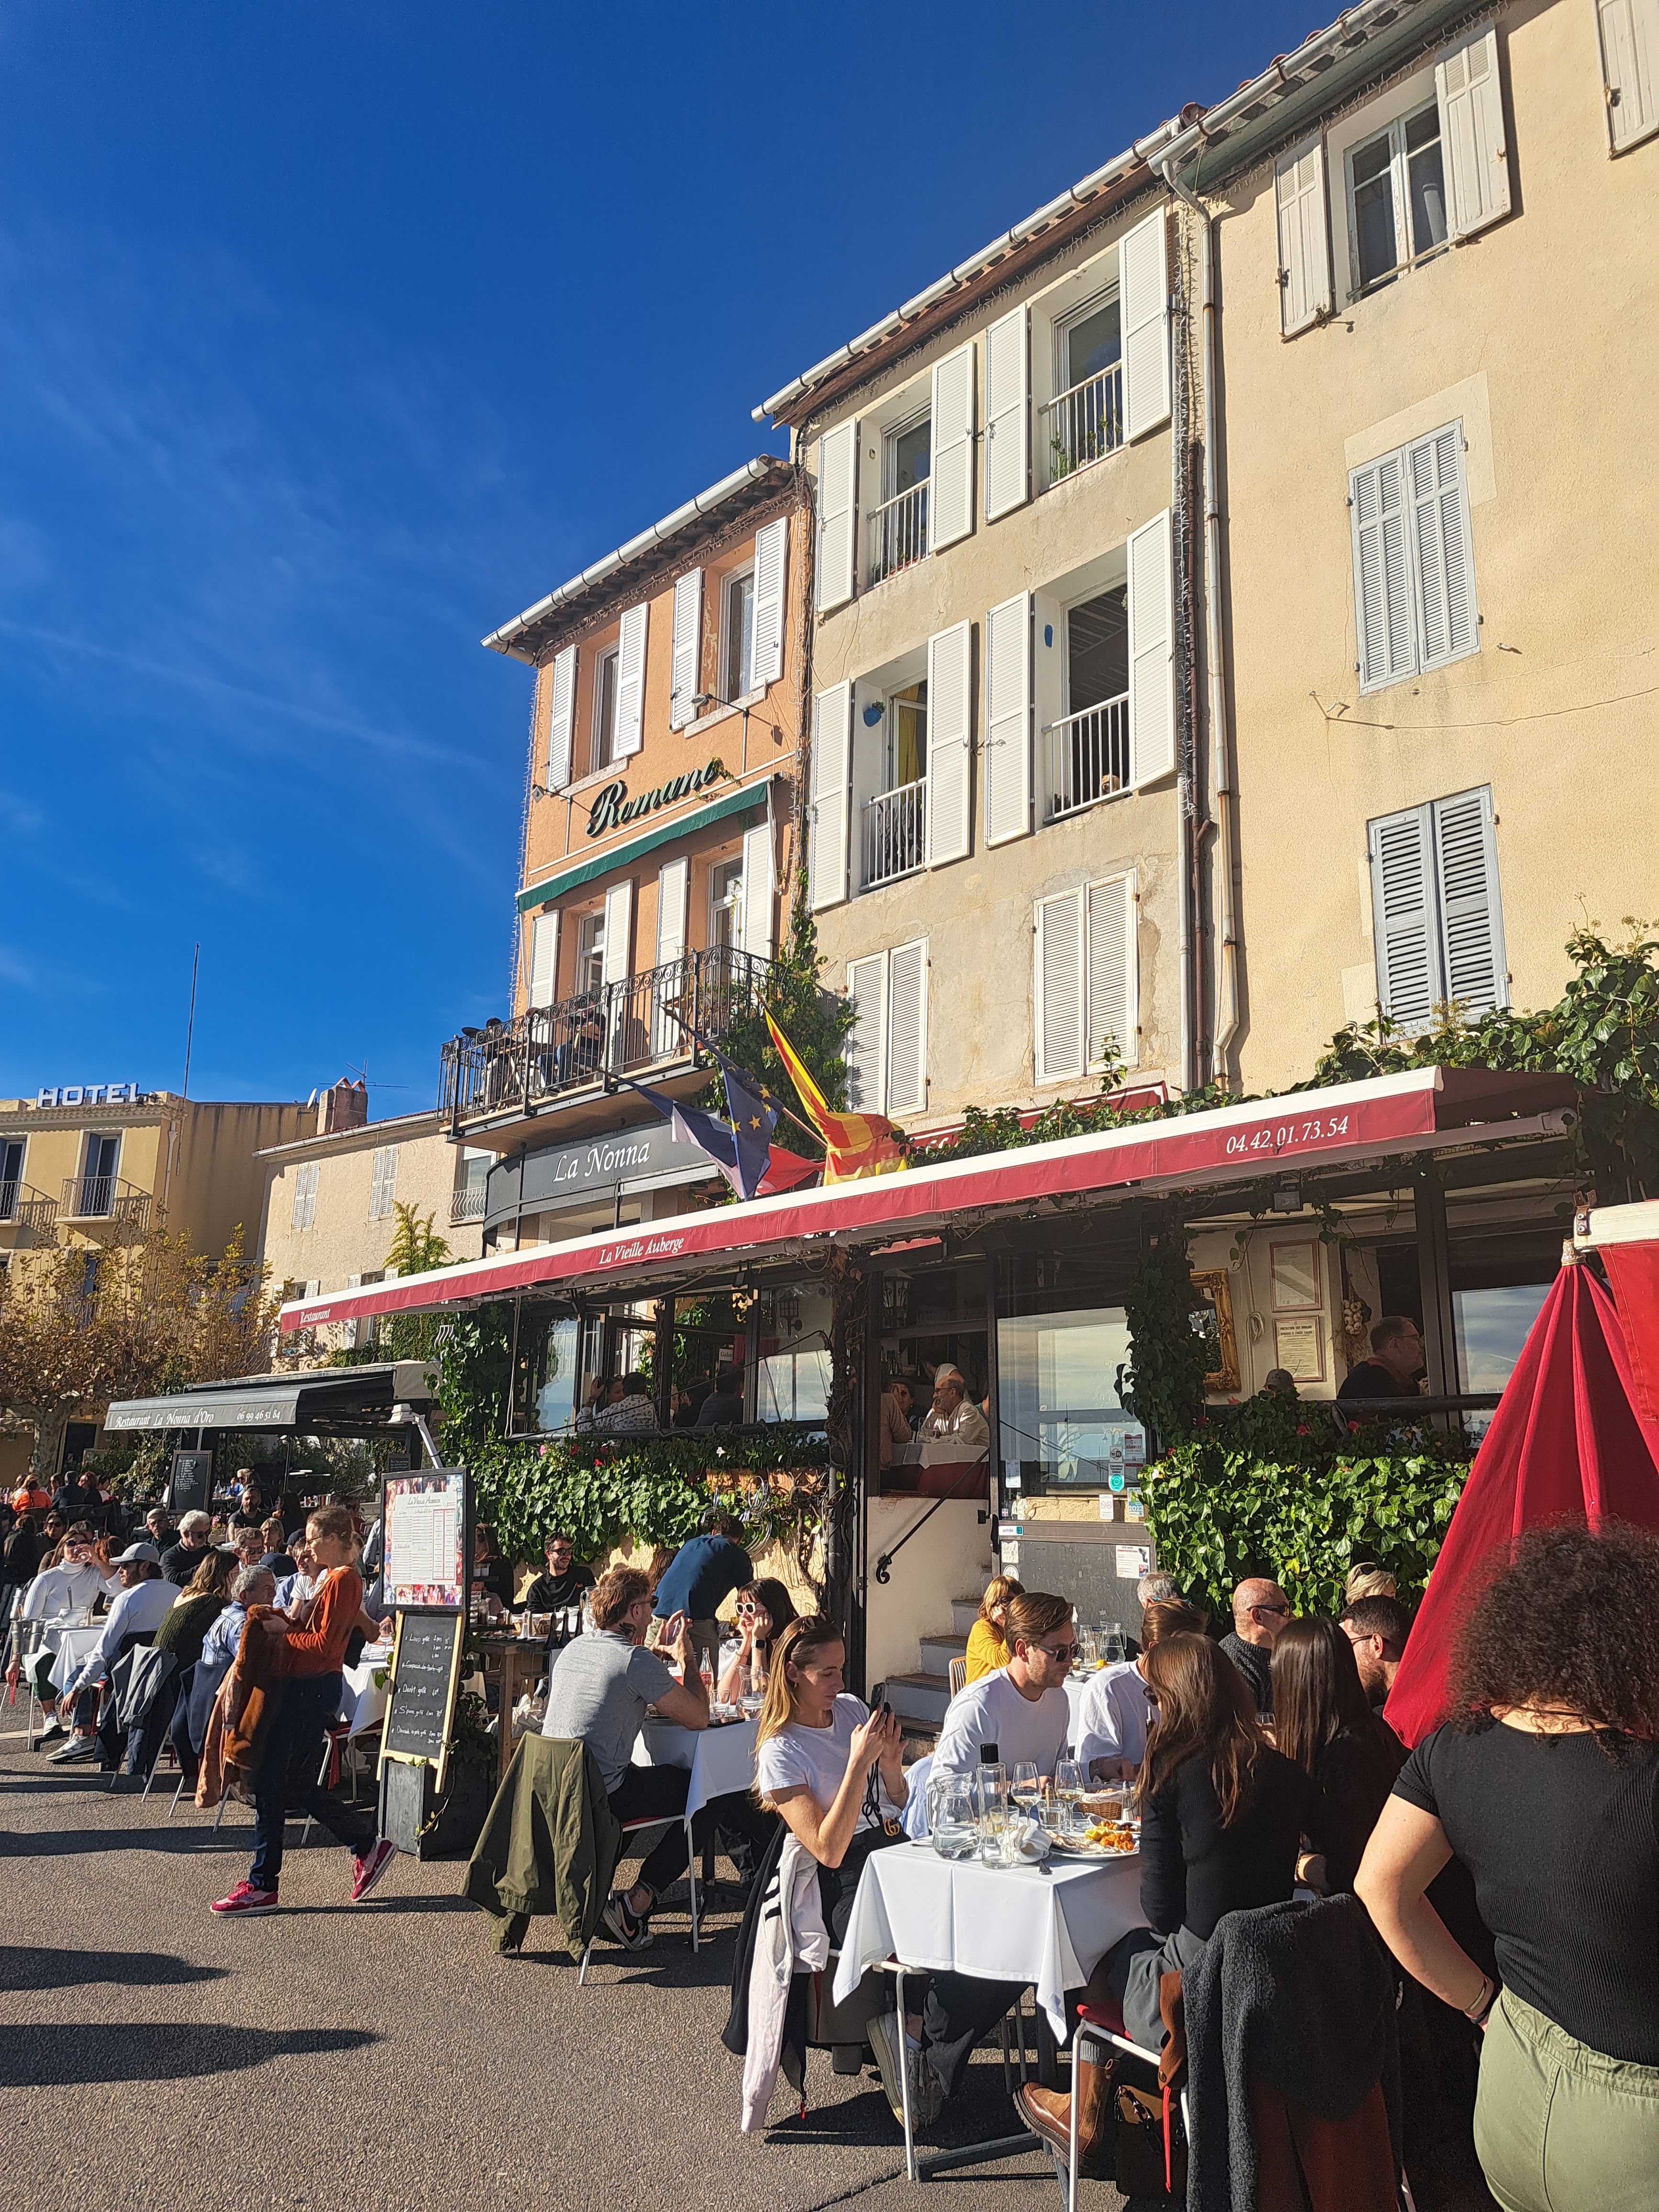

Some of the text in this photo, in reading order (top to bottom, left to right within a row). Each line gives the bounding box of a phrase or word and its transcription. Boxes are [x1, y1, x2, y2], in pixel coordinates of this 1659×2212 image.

[585, 758, 719, 837] Romano
[37, 1082, 147, 1108] HOTEL
[1226, 1115, 1349, 1154] 04.42.01.73.54
[553, 1142, 651, 1182] La Nonna
[598, 1237, 685, 1264] La Vieille Auberge
[299, 1308, 331, 1324] Restaurant
[115, 1407, 214, 1427] Restaurant La Nonna d'Oro
[237, 1409, 281, 1422] 06 99 46 51 84
